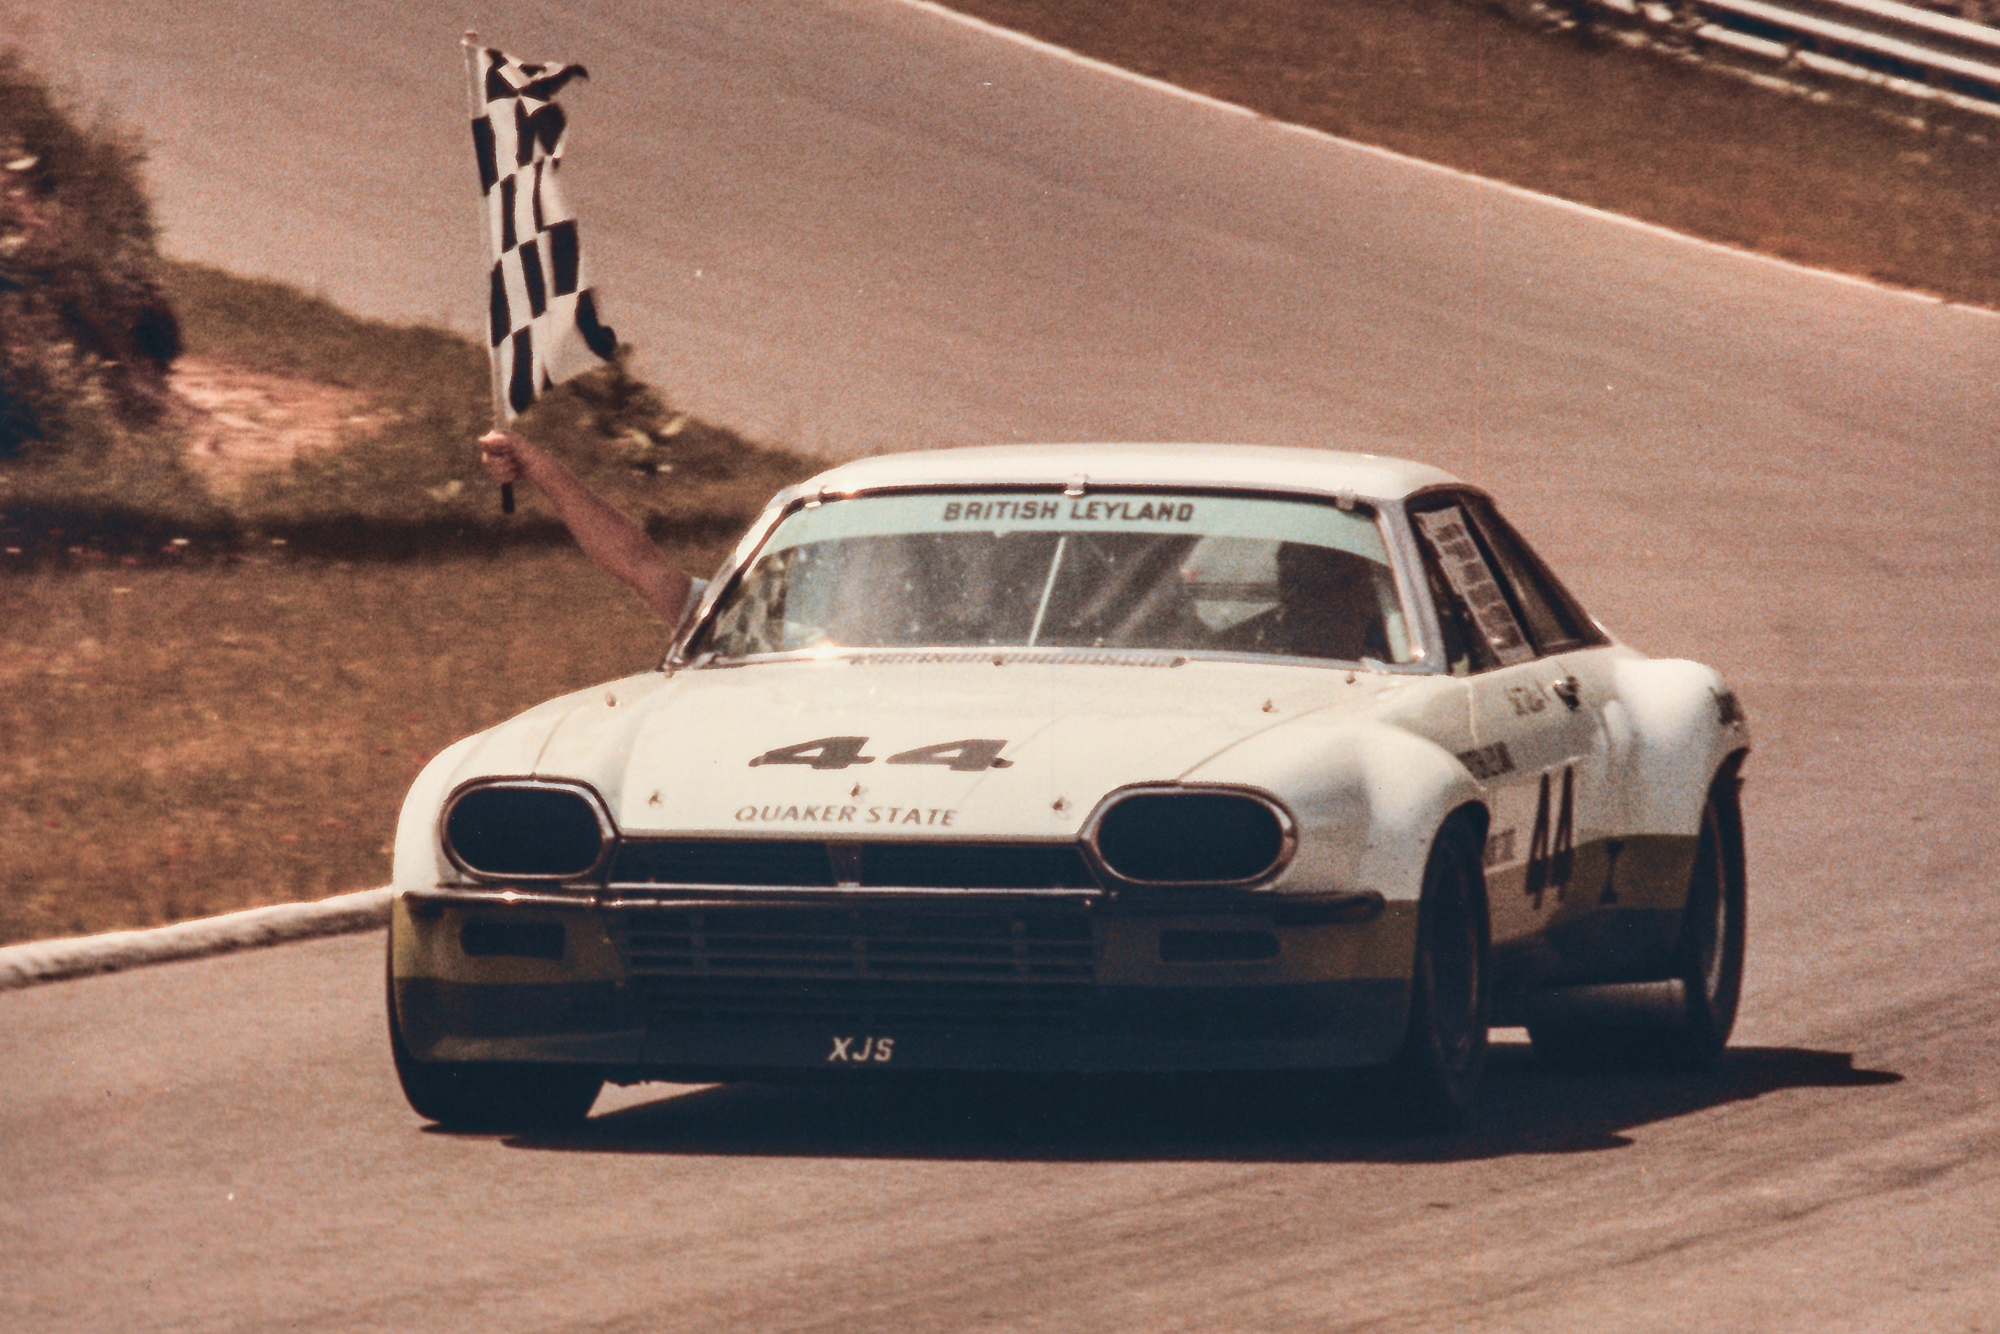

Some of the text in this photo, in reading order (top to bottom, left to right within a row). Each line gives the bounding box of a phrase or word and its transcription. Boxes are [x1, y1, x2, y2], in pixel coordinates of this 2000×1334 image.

[943, 501, 1195, 522] BRITISH LEYLAND
[748, 736, 1014, 771] 44
[735, 805, 957, 826] QUAKER STATE
[828, 1036, 895, 1061] XJS
